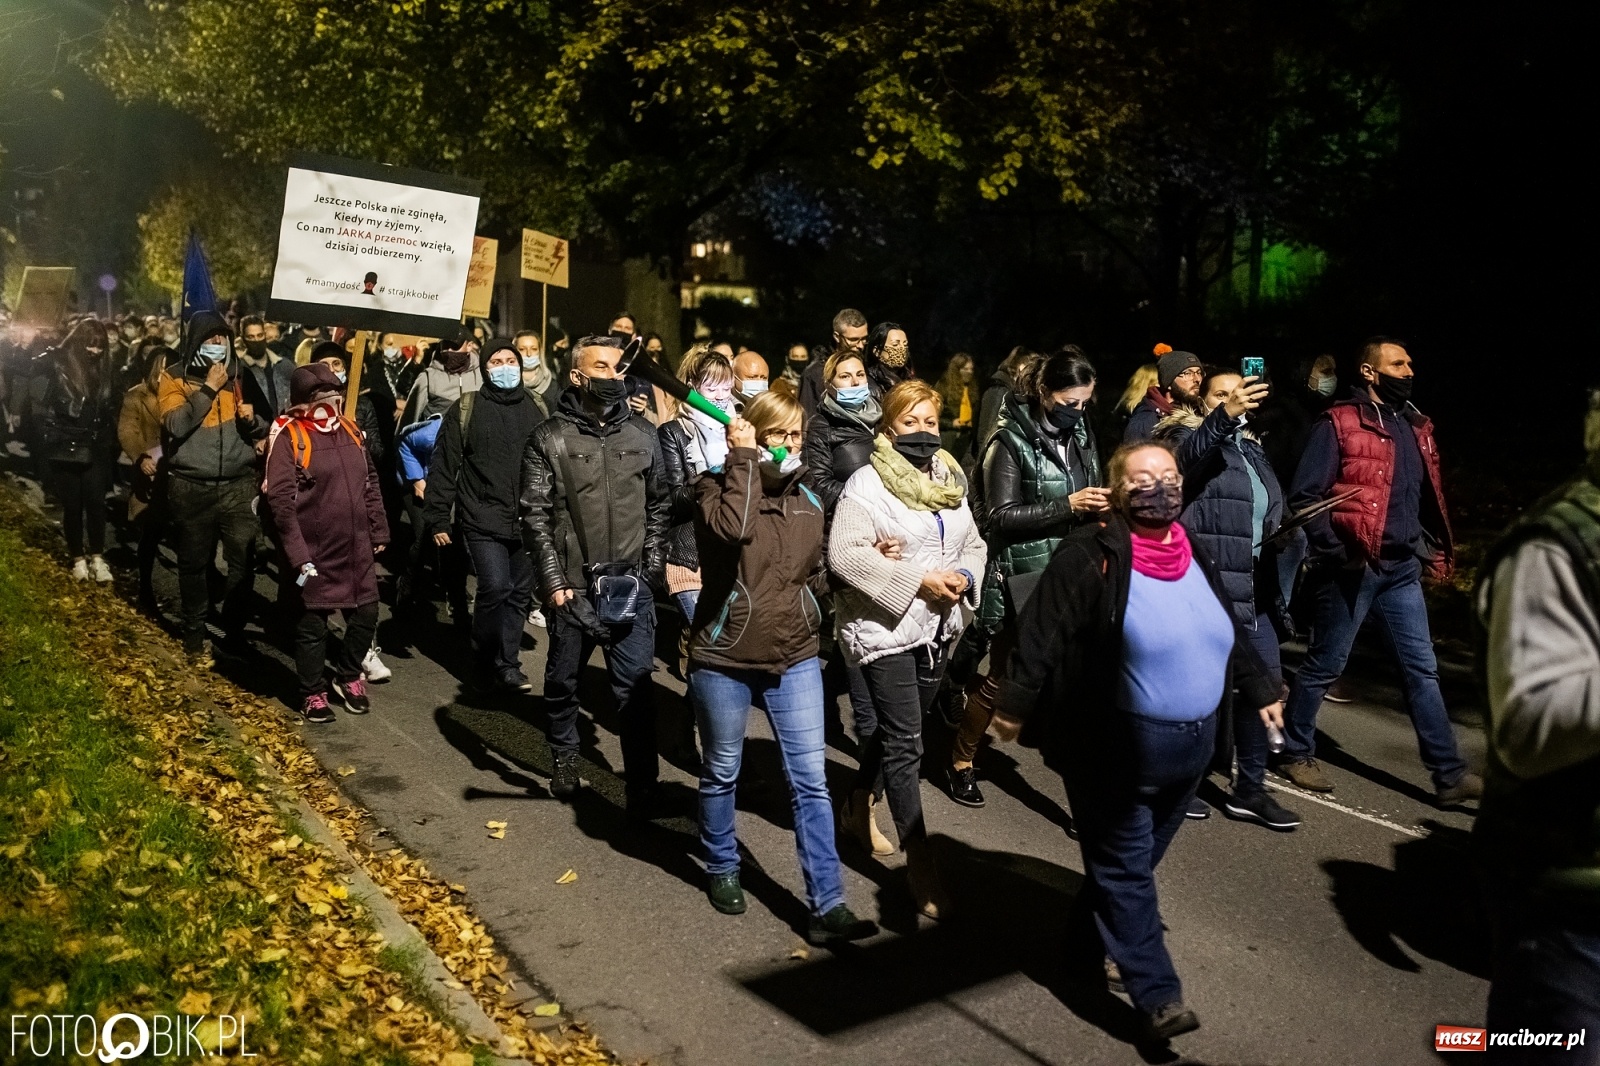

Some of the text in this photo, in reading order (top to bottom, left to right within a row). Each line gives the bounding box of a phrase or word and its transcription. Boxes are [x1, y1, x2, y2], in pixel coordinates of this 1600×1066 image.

[314, 194, 448, 224] Jeszcze Polska nie zginęła,
[334, 211, 422, 234] Kiedy my żyjemy.
[296, 221, 456, 254] Co nam JARKA przemoc wzięła,
[325, 240, 423, 262] dzisiaj odbierzemy.
